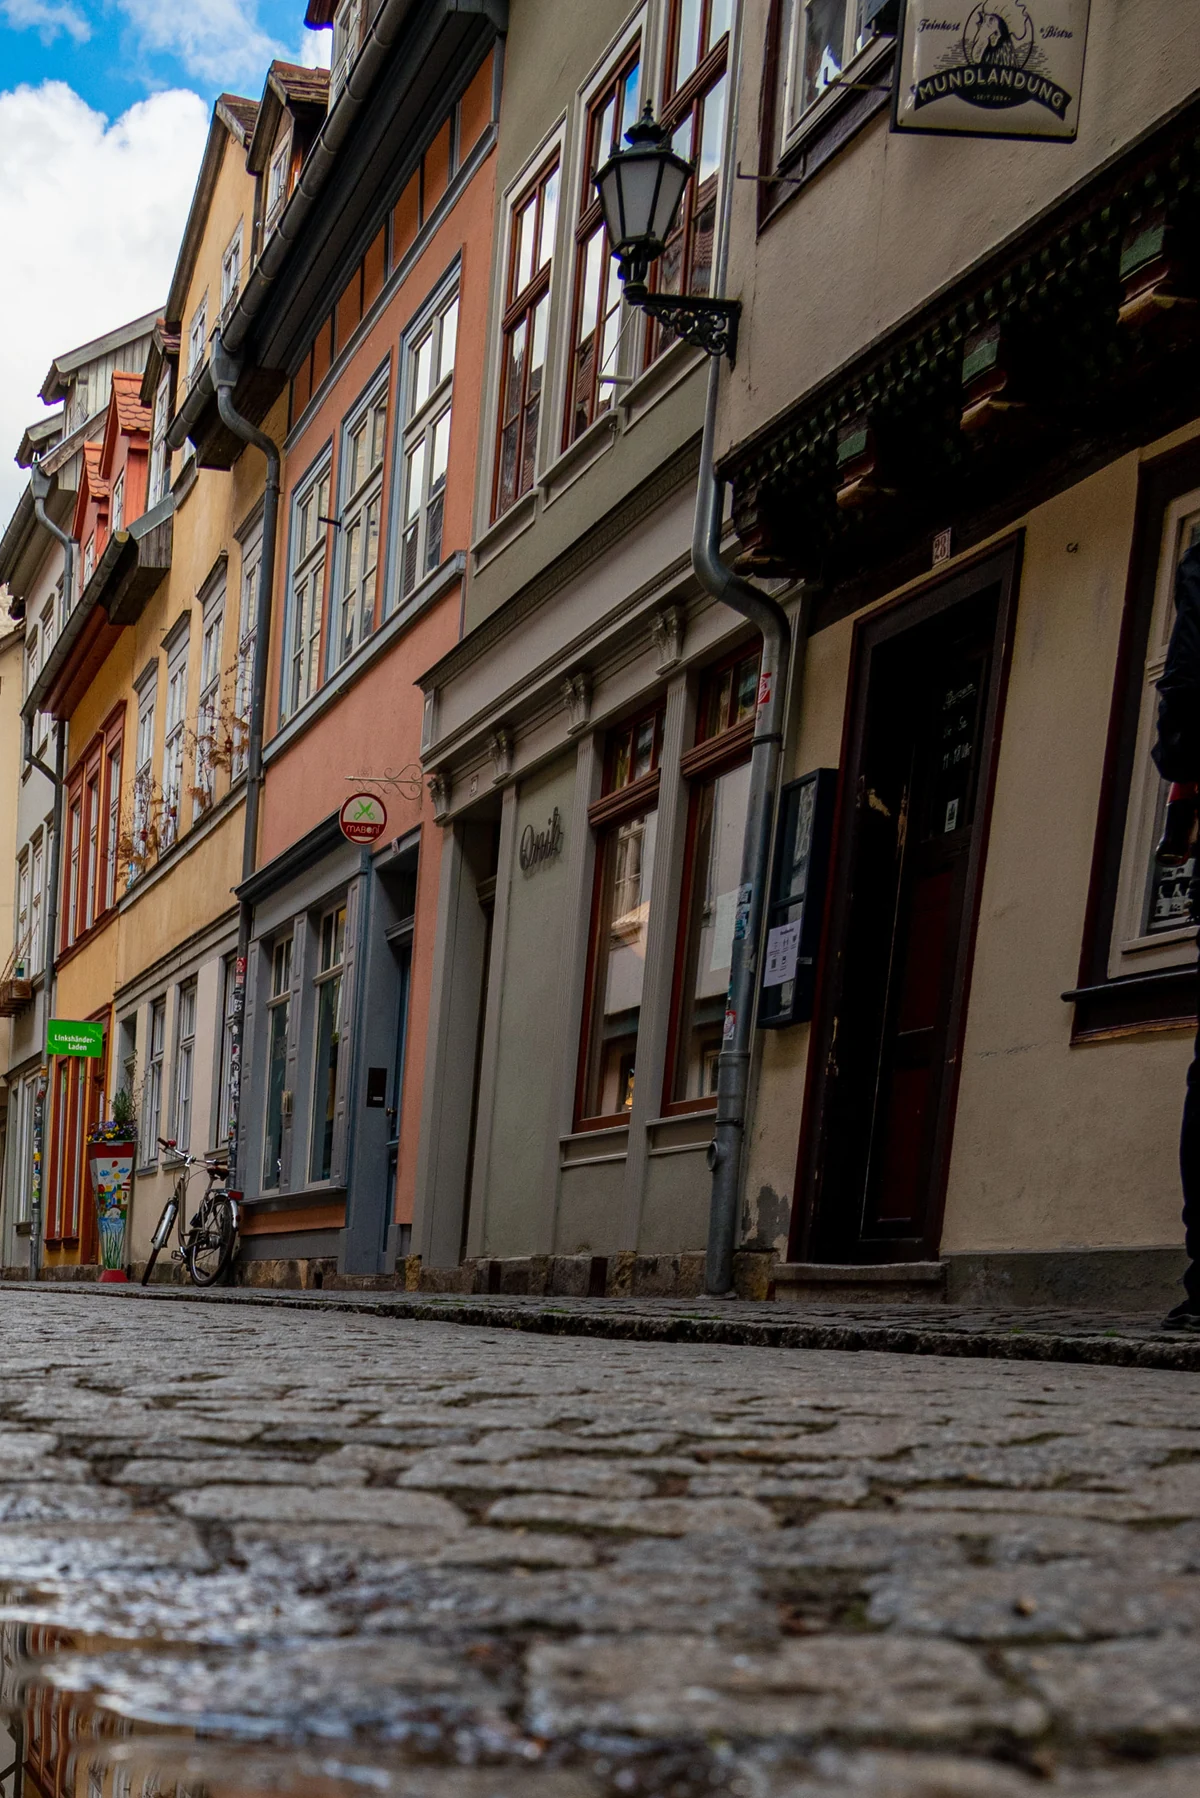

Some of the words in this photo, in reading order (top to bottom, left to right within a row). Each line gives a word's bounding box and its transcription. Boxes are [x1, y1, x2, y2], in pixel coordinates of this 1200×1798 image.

[917, 18, 961, 33] Feinkost
[1042, 25, 1073, 39] Bistro
[918, 67, 1065, 111] MUNDLANDUNG
[934, 534, 947, 560] 28
[68, 1043, 87, 1051] Laden
